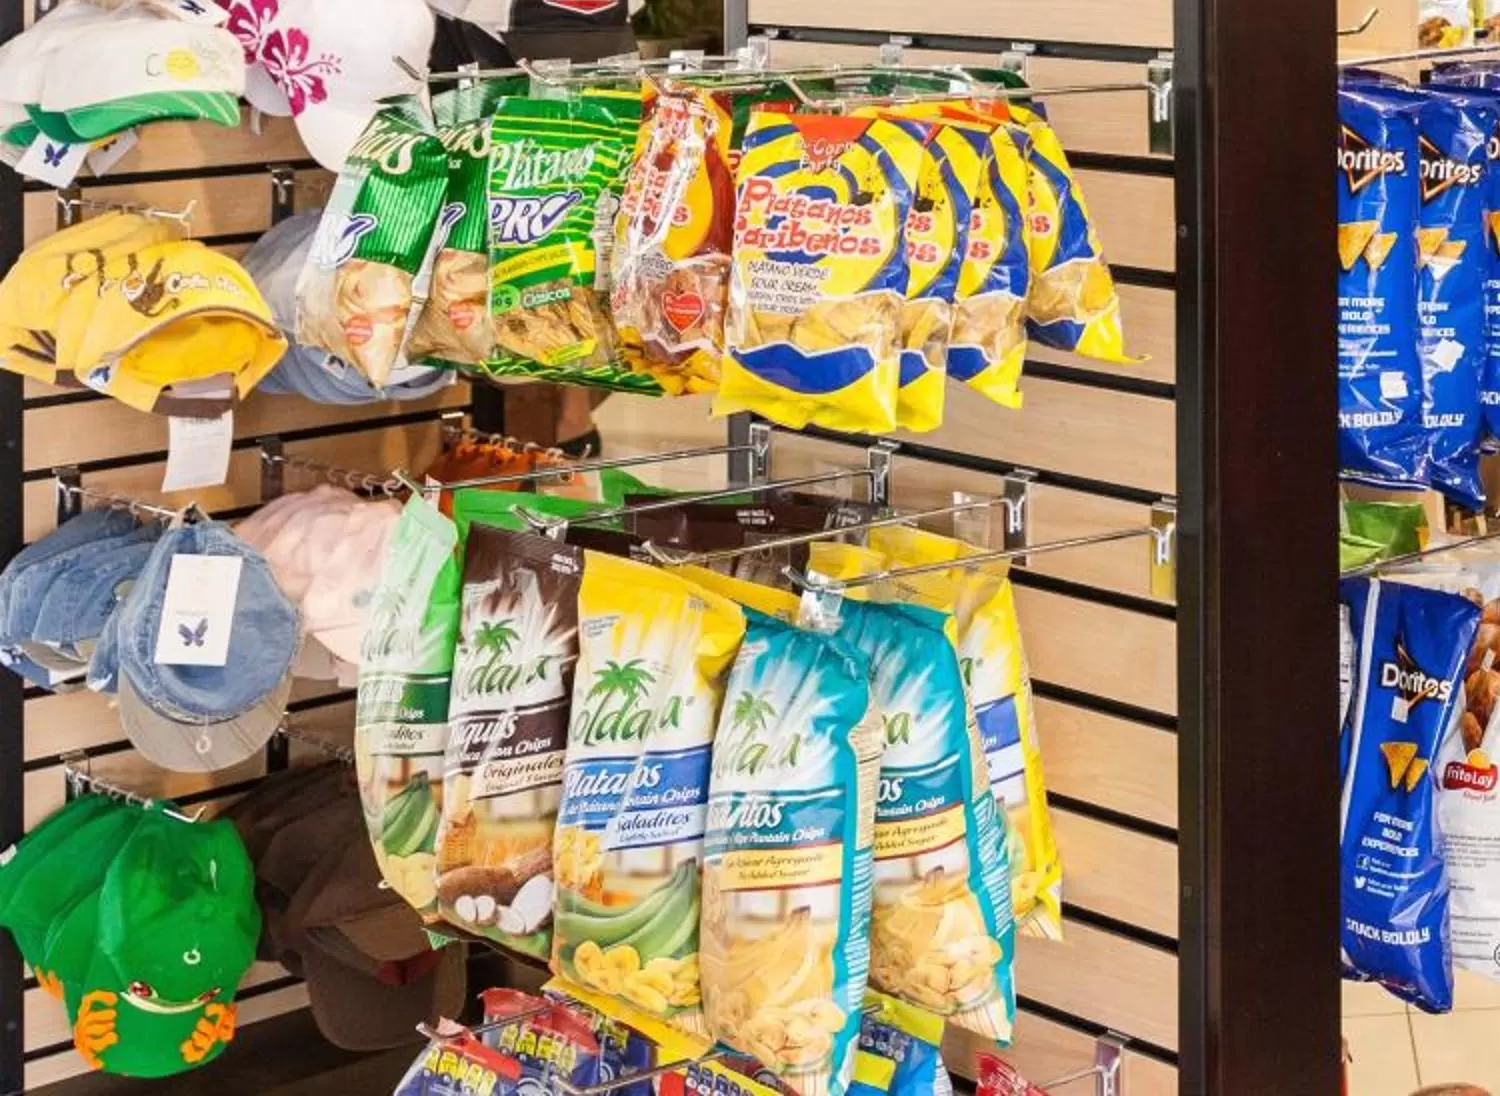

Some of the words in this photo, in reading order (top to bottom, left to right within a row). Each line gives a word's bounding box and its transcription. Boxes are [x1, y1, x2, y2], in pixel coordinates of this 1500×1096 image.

[1337, 147, 1406, 173] oritos
[1420, 159, 1481, 184] oritos
[1381, 662, 1452, 701] Doritos
[664, 786, 701, 803] Chips
[1382, 926, 1432, 946] BOLDLY
